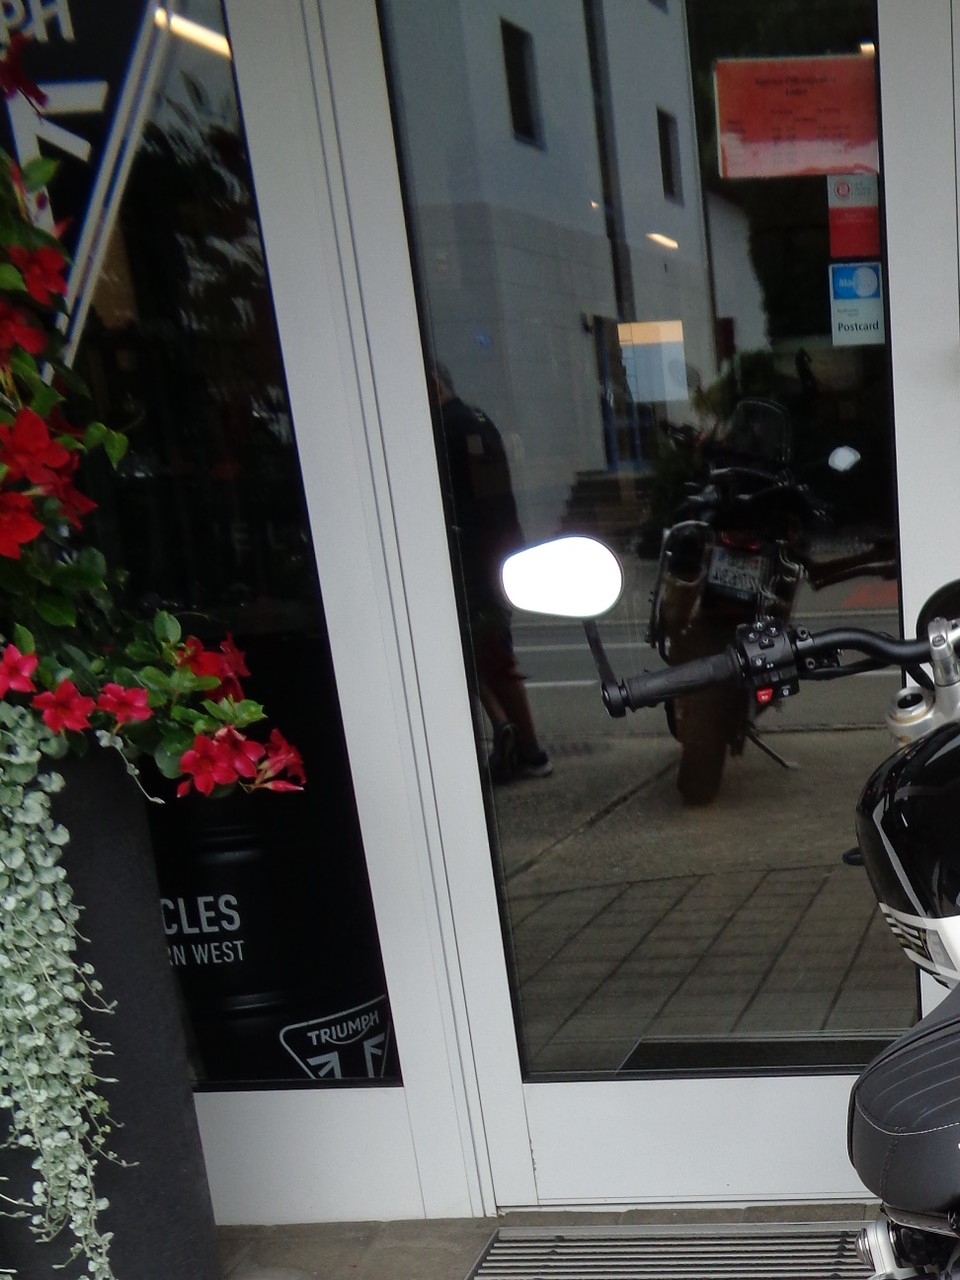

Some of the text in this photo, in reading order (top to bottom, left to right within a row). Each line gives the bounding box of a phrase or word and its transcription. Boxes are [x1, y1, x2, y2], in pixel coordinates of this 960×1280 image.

[837, 321, 880, 332] Postcard
[192, 939, 245, 966] WEST
[306, 1010, 379, 1046] TRIUMPH
